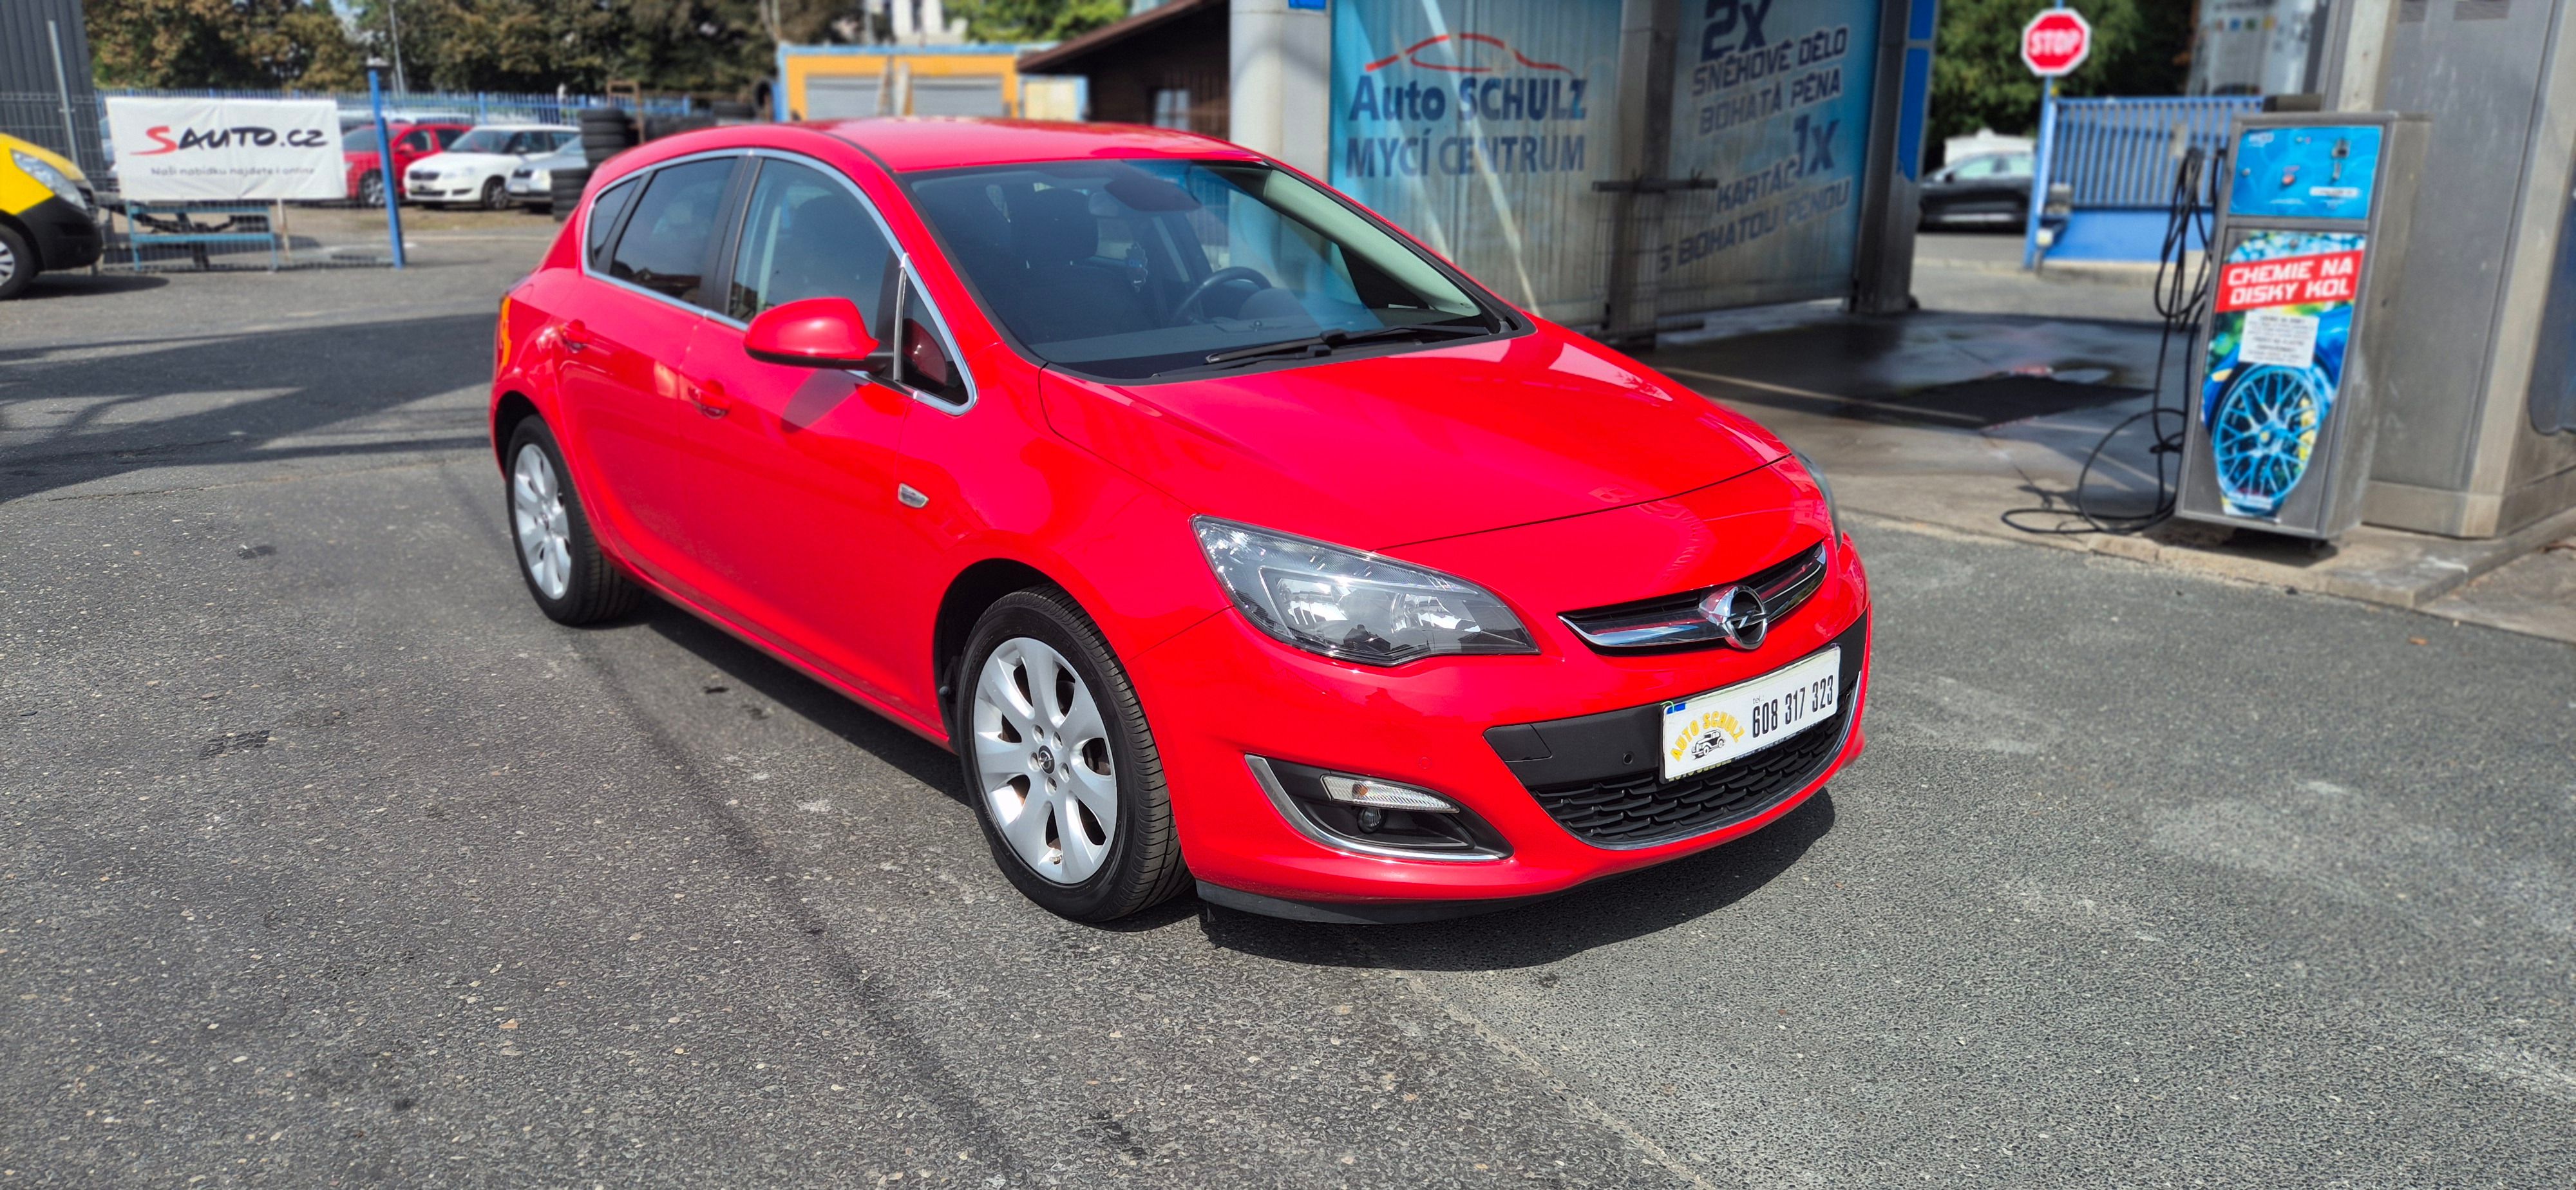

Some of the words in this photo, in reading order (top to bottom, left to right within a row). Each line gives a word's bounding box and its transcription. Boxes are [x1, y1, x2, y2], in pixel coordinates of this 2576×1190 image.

[1797, 26, 1849, 67] DĚLO
[2031, 29, 2081, 57] STOP
[1349, 75, 1446, 122] Auto
[1459, 76, 1587, 121] SCHULZ
[1789, 68, 1841, 108] PĚNA
[229, 166, 273, 178] najdete
[1345, 128, 1430, 178] MYCÍ
[1439, 135, 1585, 175] CENTRUM
[1677, 205, 1779, 266] BOHATOU
[2228, 260, 2315, 287] CHEMIE
[2320, 256, 2353, 278] NA
[2230, 282, 2300, 306] DISKY
[2304, 278, 2350, 299] KOL
[1752, 699, 1778, 738] 608
[1785, 687, 1806, 725] 317
[1812, 675, 1833, 713] 323
[1670, 720, 1700, 762] AUTO
[1702, 710, 1745, 743] SCHULZ
